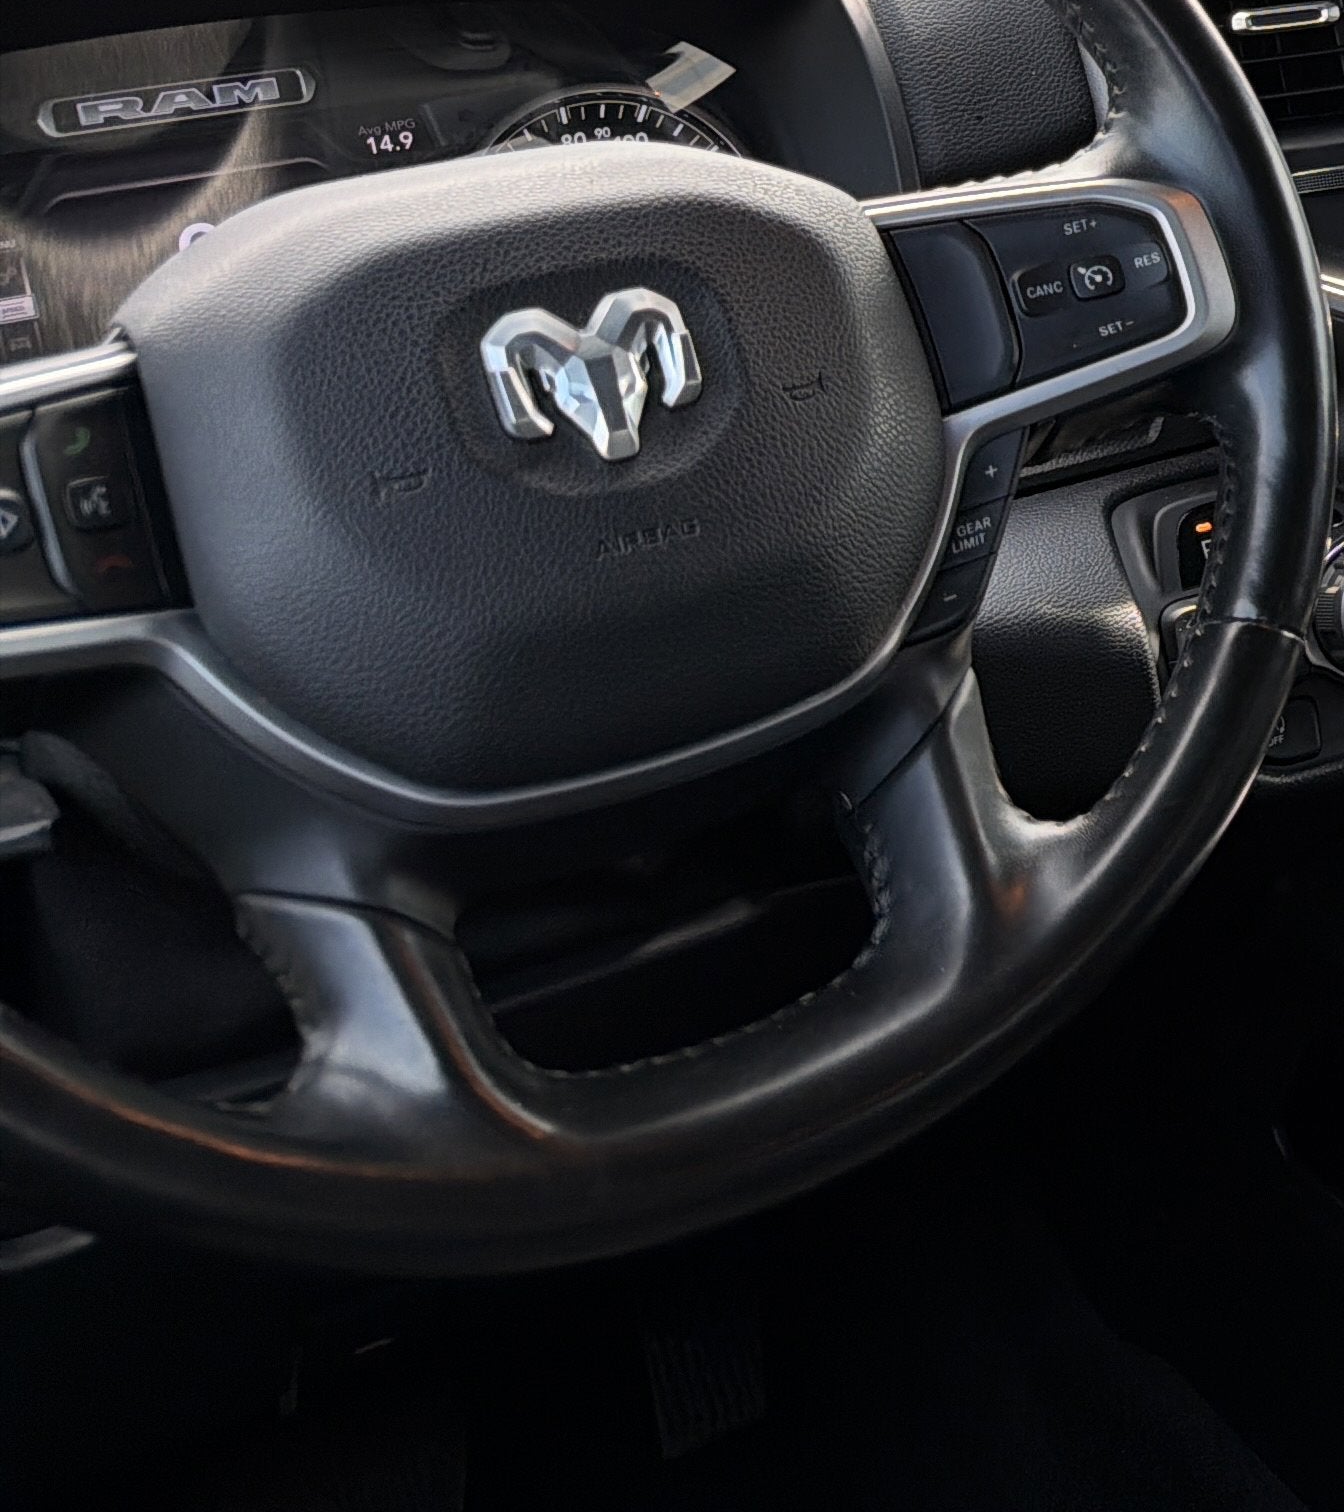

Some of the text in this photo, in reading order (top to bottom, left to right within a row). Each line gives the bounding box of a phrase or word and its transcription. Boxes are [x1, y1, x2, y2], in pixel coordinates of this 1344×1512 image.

[74, 75, 281, 127] RAM
[358, 118, 417, 139] Avg MPG
[594, 127, 611, 139] 90
[365, 131, 415, 156] 14.9
[1133, 251, 1161, 269] RES
[1026, 279, 1064, 299] CANC
[956, 516, 991, 538] GEAR
[952, 532, 987, 554] LIMIT
